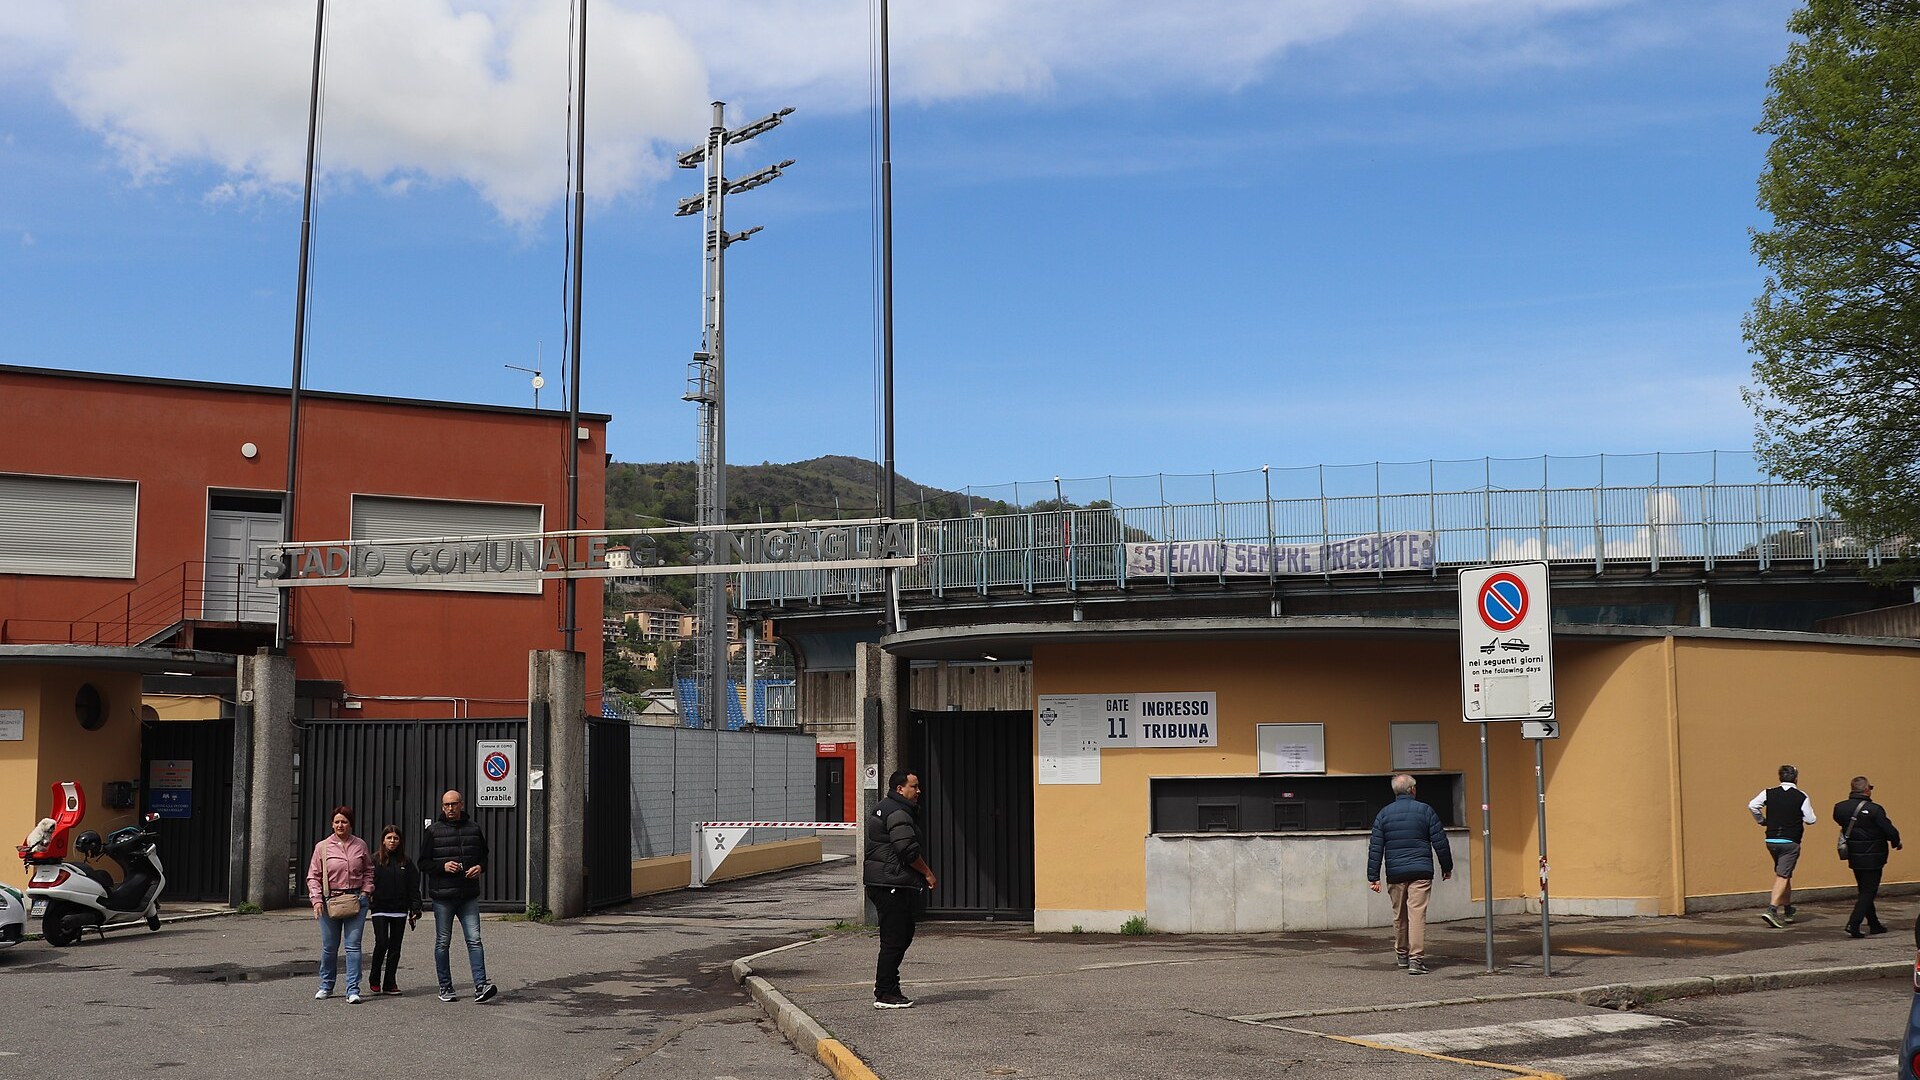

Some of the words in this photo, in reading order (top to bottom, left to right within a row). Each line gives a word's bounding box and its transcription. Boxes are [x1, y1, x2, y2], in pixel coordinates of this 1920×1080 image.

[264, 546, 385, 578] STADIO
[405, 536, 609, 575] COMUNALE
[688, 524, 908, 564] SINIGAGLIA
[1145, 543, 1228, 573] STEFANO
[1235, 544, 1312, 573] SEMPRE
[1320, 534, 1419, 572] PRESENTE
[1484, 657, 1517, 666] seguenti
[1520, 656, 1544, 665] giorni
[1106, 699, 1129, 712] GATE
[1142, 701, 1209, 717] INGRESSO
[1107, 718, 1129, 739] 11
[1142, 723, 1209, 739] TRIBUNA
[480, 794, 512, 802] carrabile
